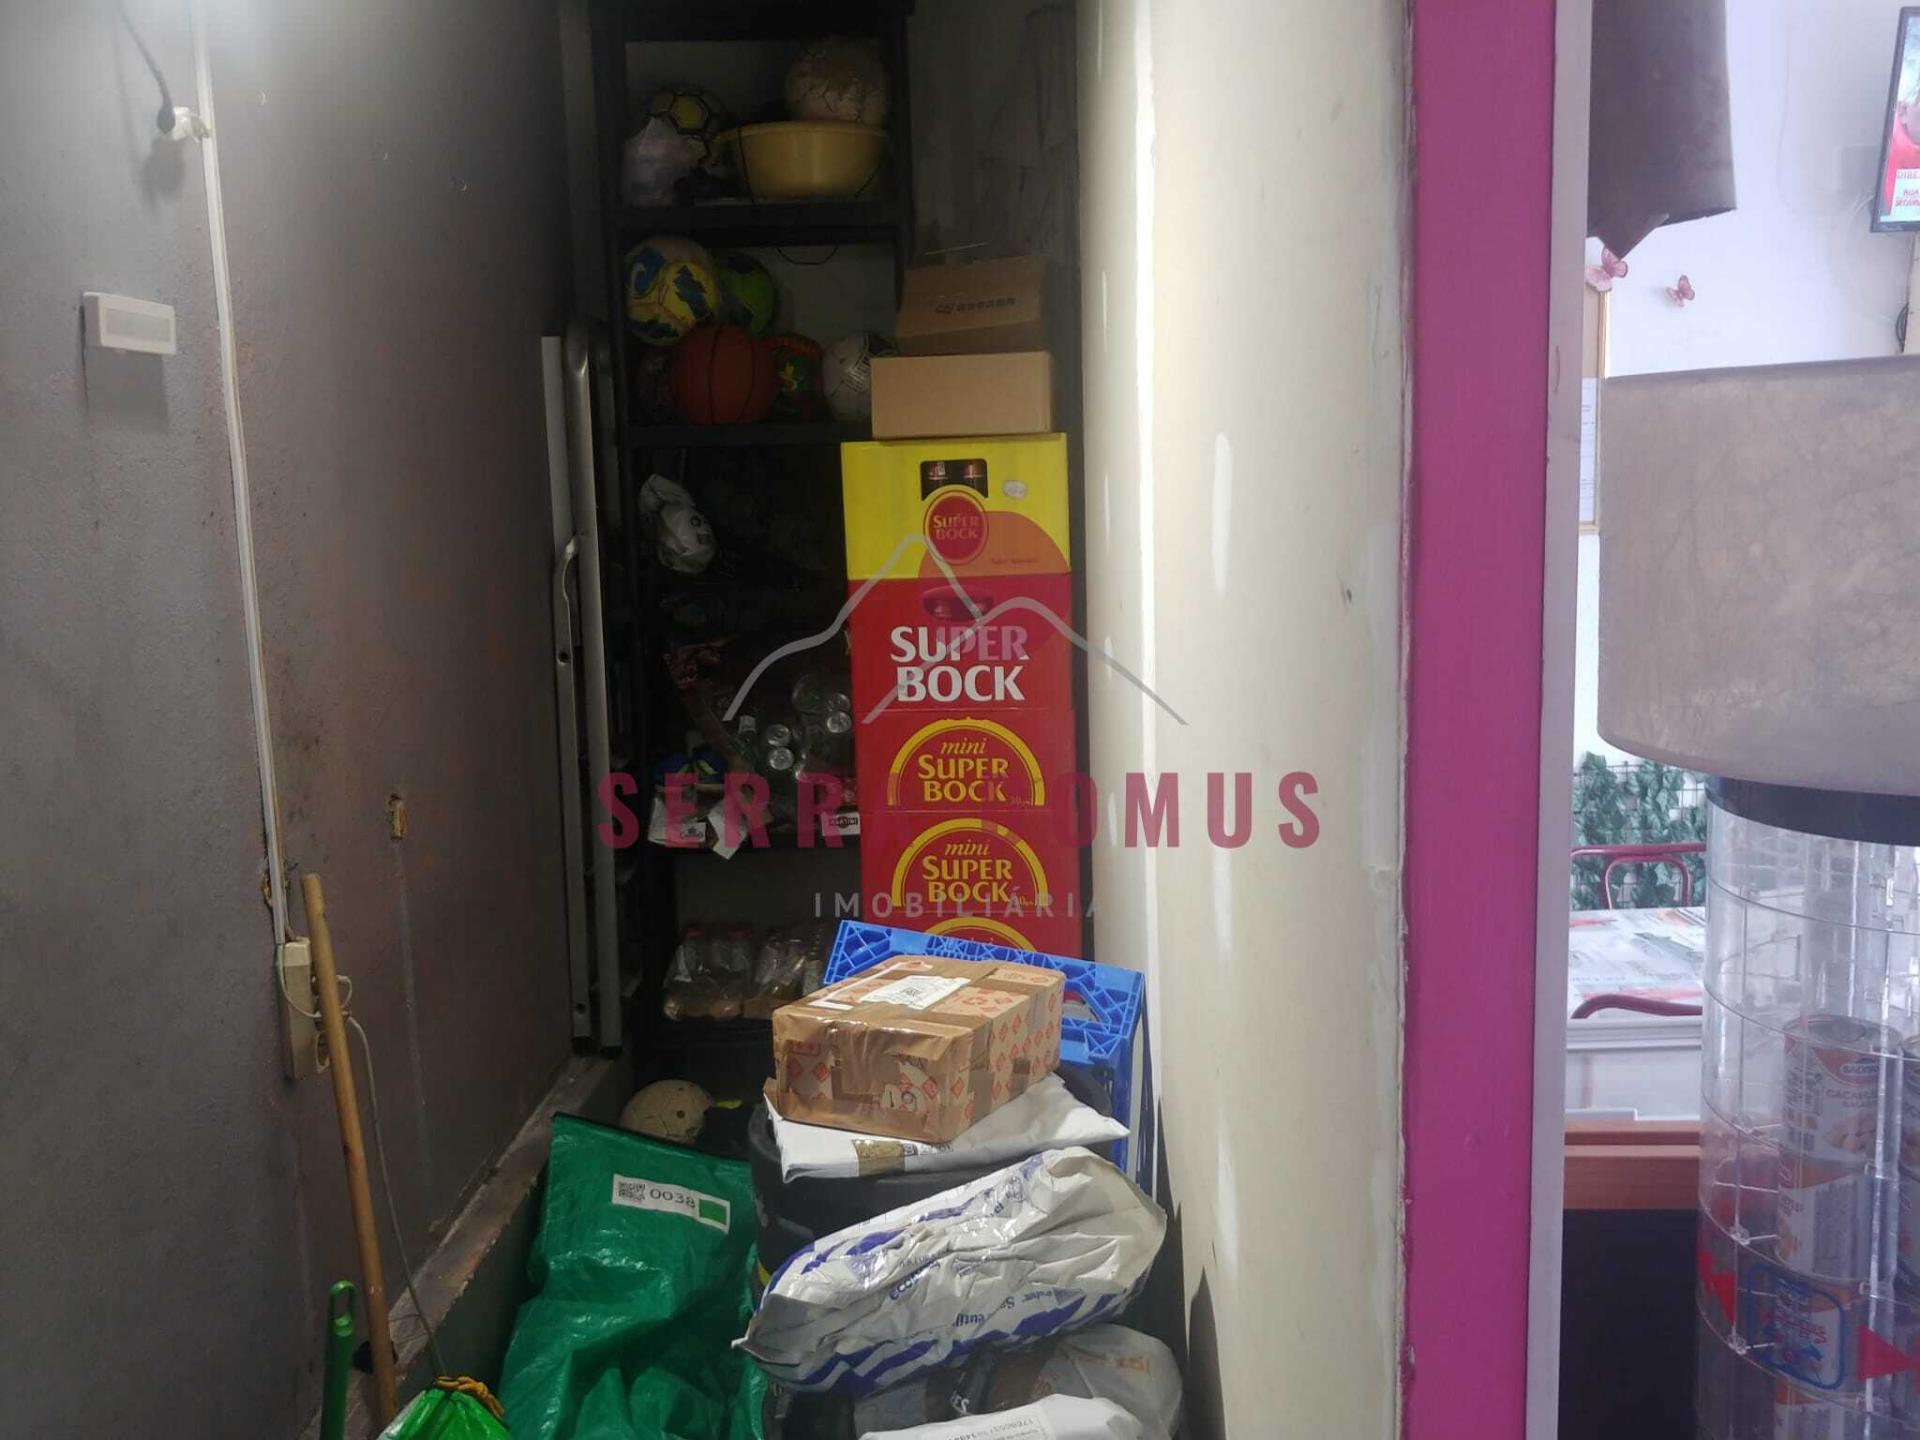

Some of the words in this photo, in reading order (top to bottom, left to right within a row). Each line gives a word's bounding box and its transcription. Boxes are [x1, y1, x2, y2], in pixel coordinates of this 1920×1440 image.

[933, 514, 979, 528] SUPER
[935, 528, 978, 539] BOCK
[890, 625, 1030, 662] SUPER
[896, 664, 1025, 702] BOCK
[940, 737, 987, 755] mini
[917, 754, 1009, 779] SUPER
[922, 780, 1008, 802] BOCK
[944, 839, 990, 856] mini
[922, 855, 1013, 880] SUPER
[927, 881, 1011, 903] BOCK
[649, 1187, 696, 1209] 0038
